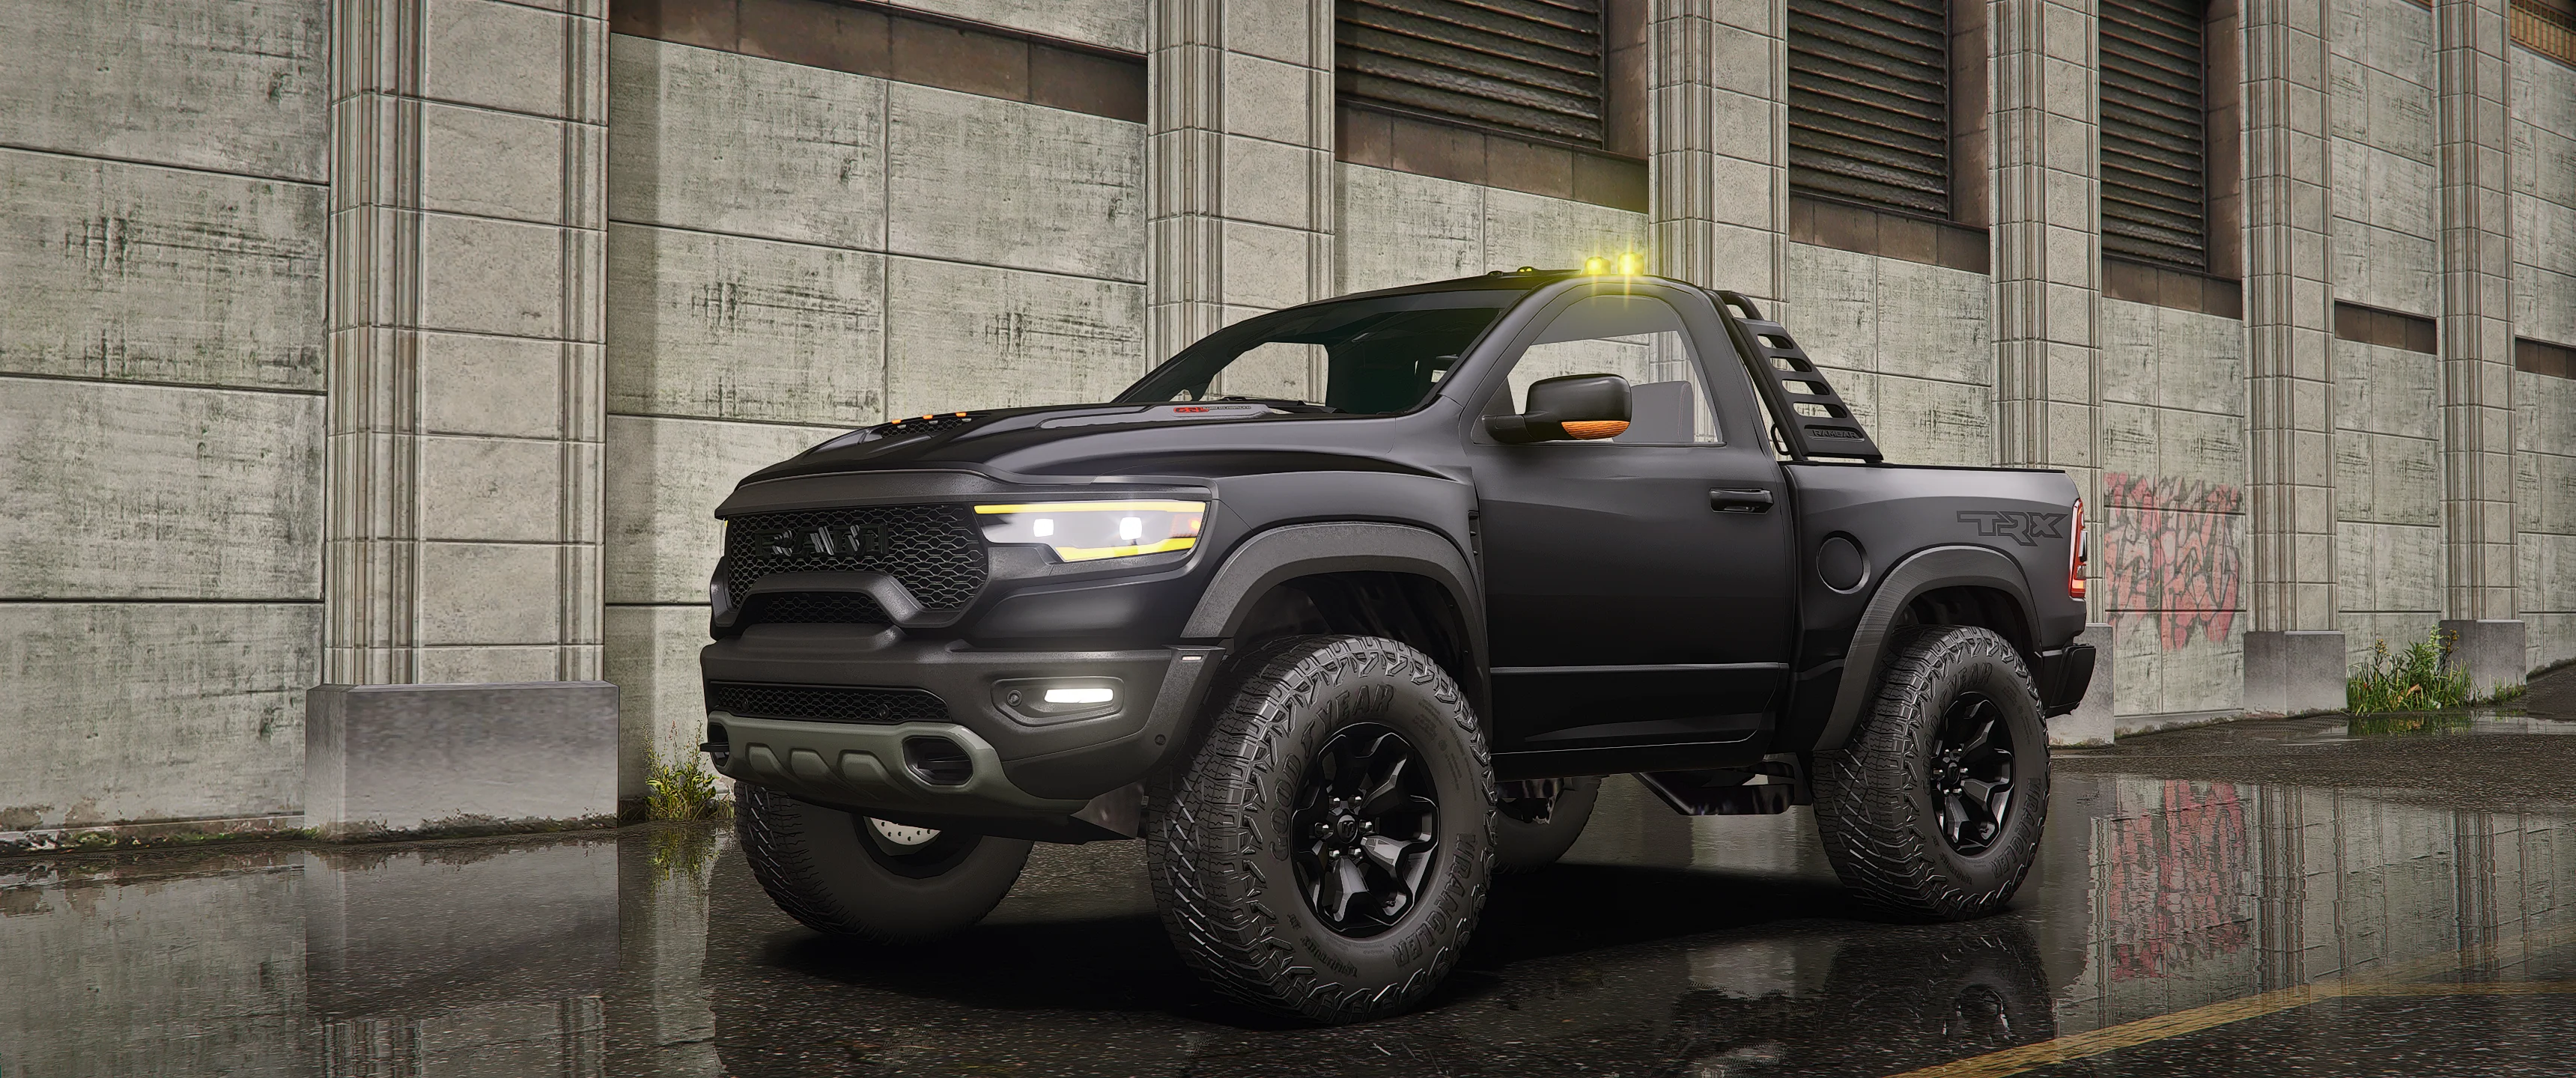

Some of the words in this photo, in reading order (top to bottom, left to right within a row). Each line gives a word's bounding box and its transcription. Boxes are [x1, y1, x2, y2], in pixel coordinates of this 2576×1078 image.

[1812, 429, 1857, 438] RAMBAR
[755, 524, 890, 557] RAM
[1957, 510, 2069, 546] TRX
[1989, 777, 2041, 878] WRANGLER
[1392, 833, 1476, 968] WRANGLER
